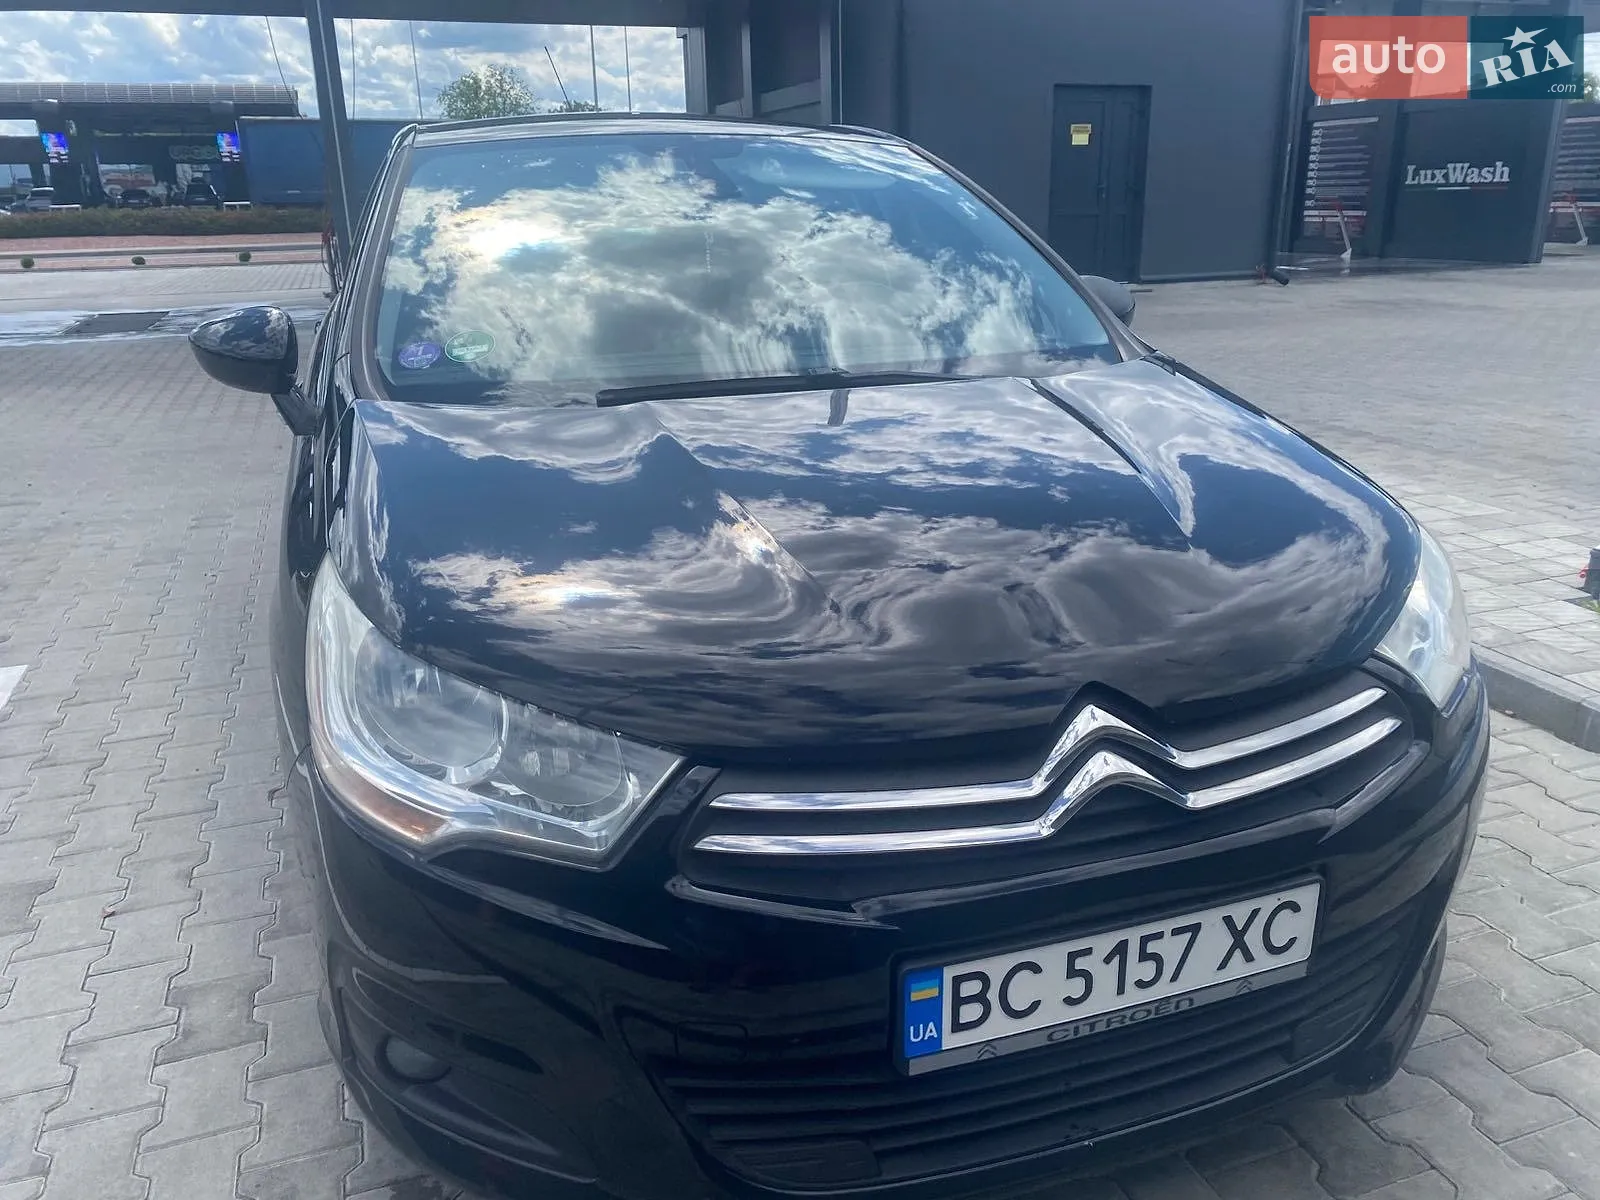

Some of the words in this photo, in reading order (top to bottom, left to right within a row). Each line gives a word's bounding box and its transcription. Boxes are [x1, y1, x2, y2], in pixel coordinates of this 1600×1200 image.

[1405, 161, 1510, 185] LuxWash
[951, 961, 1042, 1033] BC
[1062, 922, 1202, 1007] 5157
[1216, 900, 1302, 971] XC
[909, 1023, 938, 1043] UA
